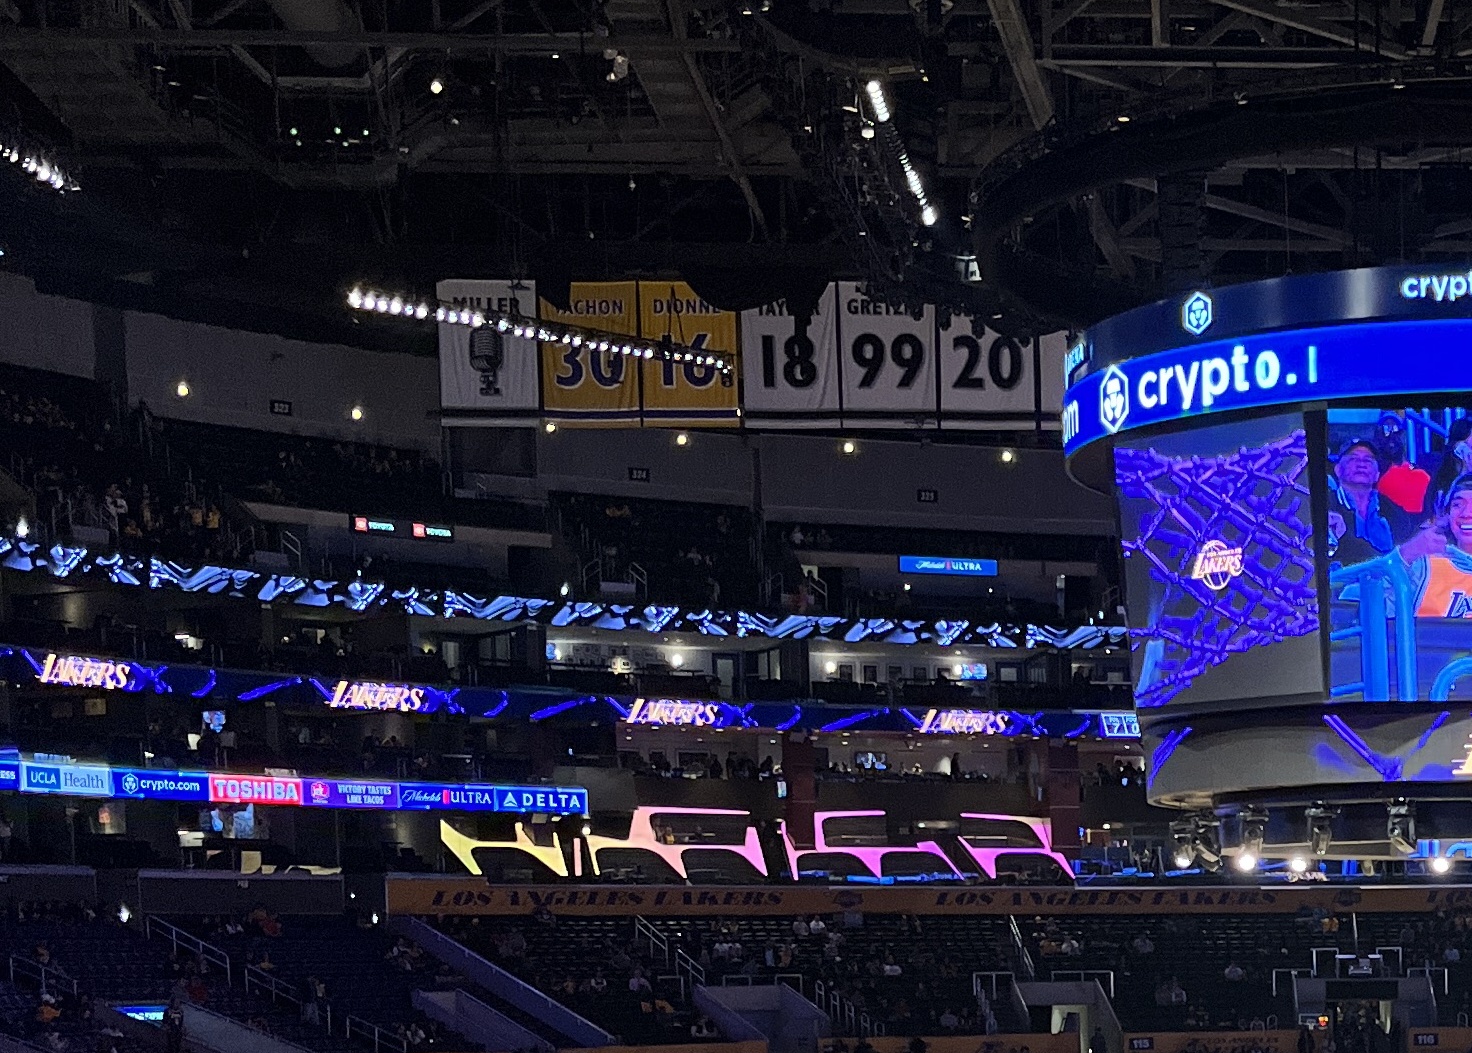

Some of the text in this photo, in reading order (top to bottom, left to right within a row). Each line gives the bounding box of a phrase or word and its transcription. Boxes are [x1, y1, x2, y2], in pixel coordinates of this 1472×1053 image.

[762, 335, 816, 389] 18
[852, 333, 923, 389] 99
[953, 334, 1023, 389] 20
[35, 653, 131, 690] LAKERS
[328, 680, 425, 713] LAKERS
[620, 697, 719, 725] LAKERS
[31, 771, 105, 789] UCLA Health
[141, 779, 200, 792] crypto.com
[214, 780, 298, 800] TOSHIBA
[451, 791, 492, 805] ULTRA
[523, 793, 581, 808] DELTA
[430, 889, 783, 908] LOS ANGELES LAKERS
